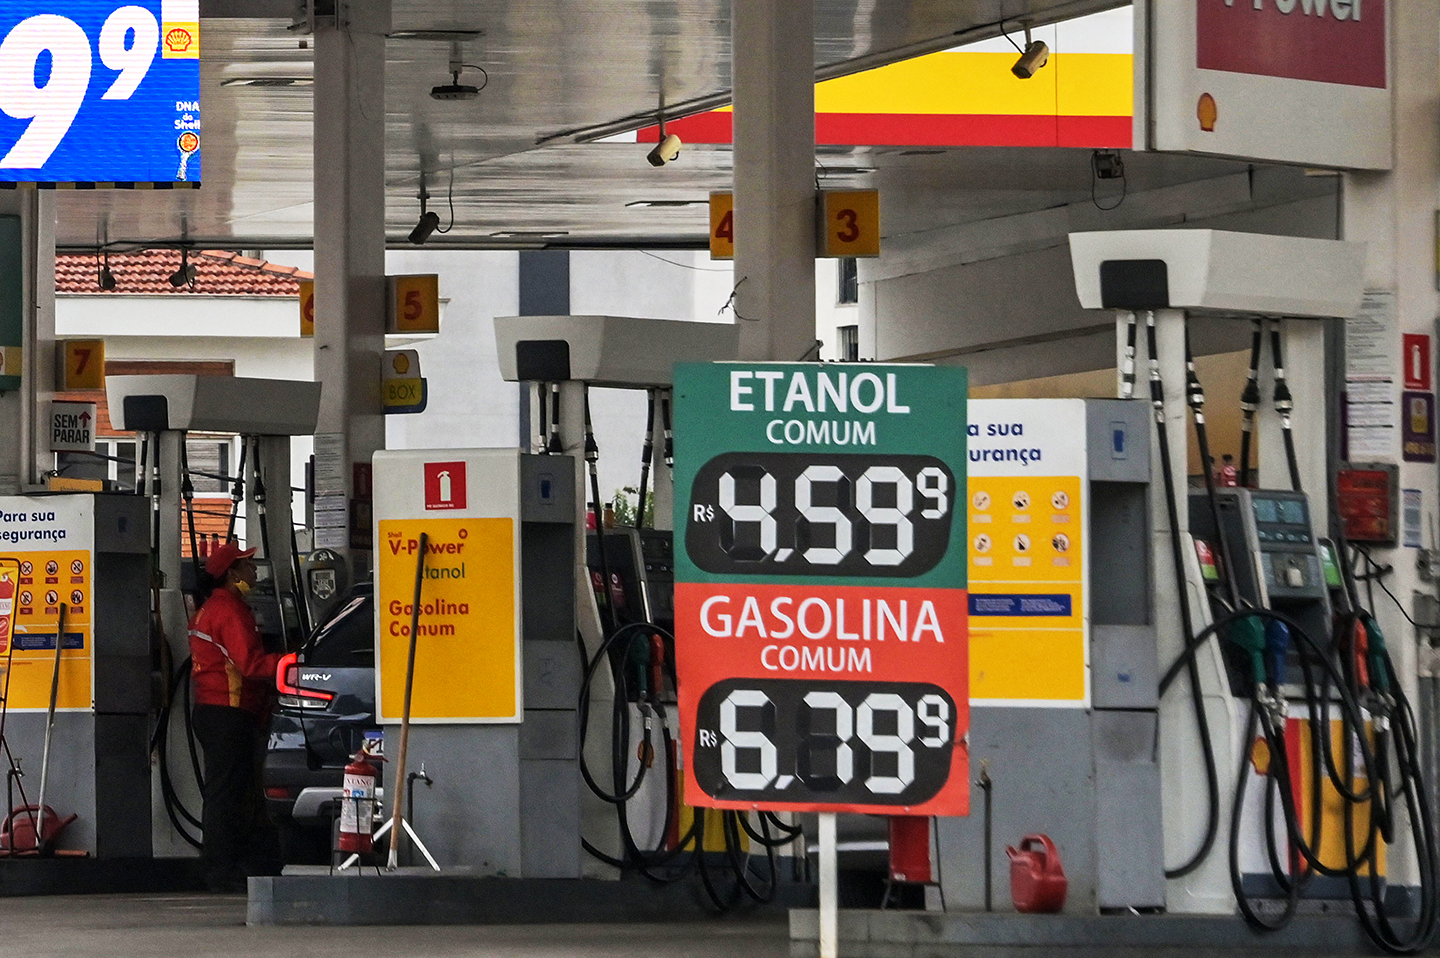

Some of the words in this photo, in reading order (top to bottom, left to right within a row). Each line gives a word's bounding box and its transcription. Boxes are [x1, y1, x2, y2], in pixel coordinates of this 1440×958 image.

[175, 101, 200, 112] DNA
[174, 119, 200, 130] Shell
[715, 210, 733, 243] 4
[836, 209, 859, 243] 3
[404, 291, 422, 320] 5
[74, 349, 91, 375] 7
[389, 384, 415, 400] BOX
[729, 370, 910, 414] ETANOL
[54, 413, 78, 428] SEM
[987, 423, 1023, 436] sua
[53, 429, 90, 443] PARAR
[766, 419, 876, 445] COMUM
[969, 448, 1041, 466] urança
[32, 511, 55, 522] sua
[693, 504, 715, 523] R$
[387, 531, 403, 539] Shell
[420, 561, 466, 580] tanol
[389, 598, 469, 616] Gasolina
[699, 594, 945, 643] GASOLINA
[389, 620, 456, 637] Comum
[760, 644, 873, 672] COMUM
[301, 673, 332, 681] WR-V
[698, 729, 717, 747] R$
